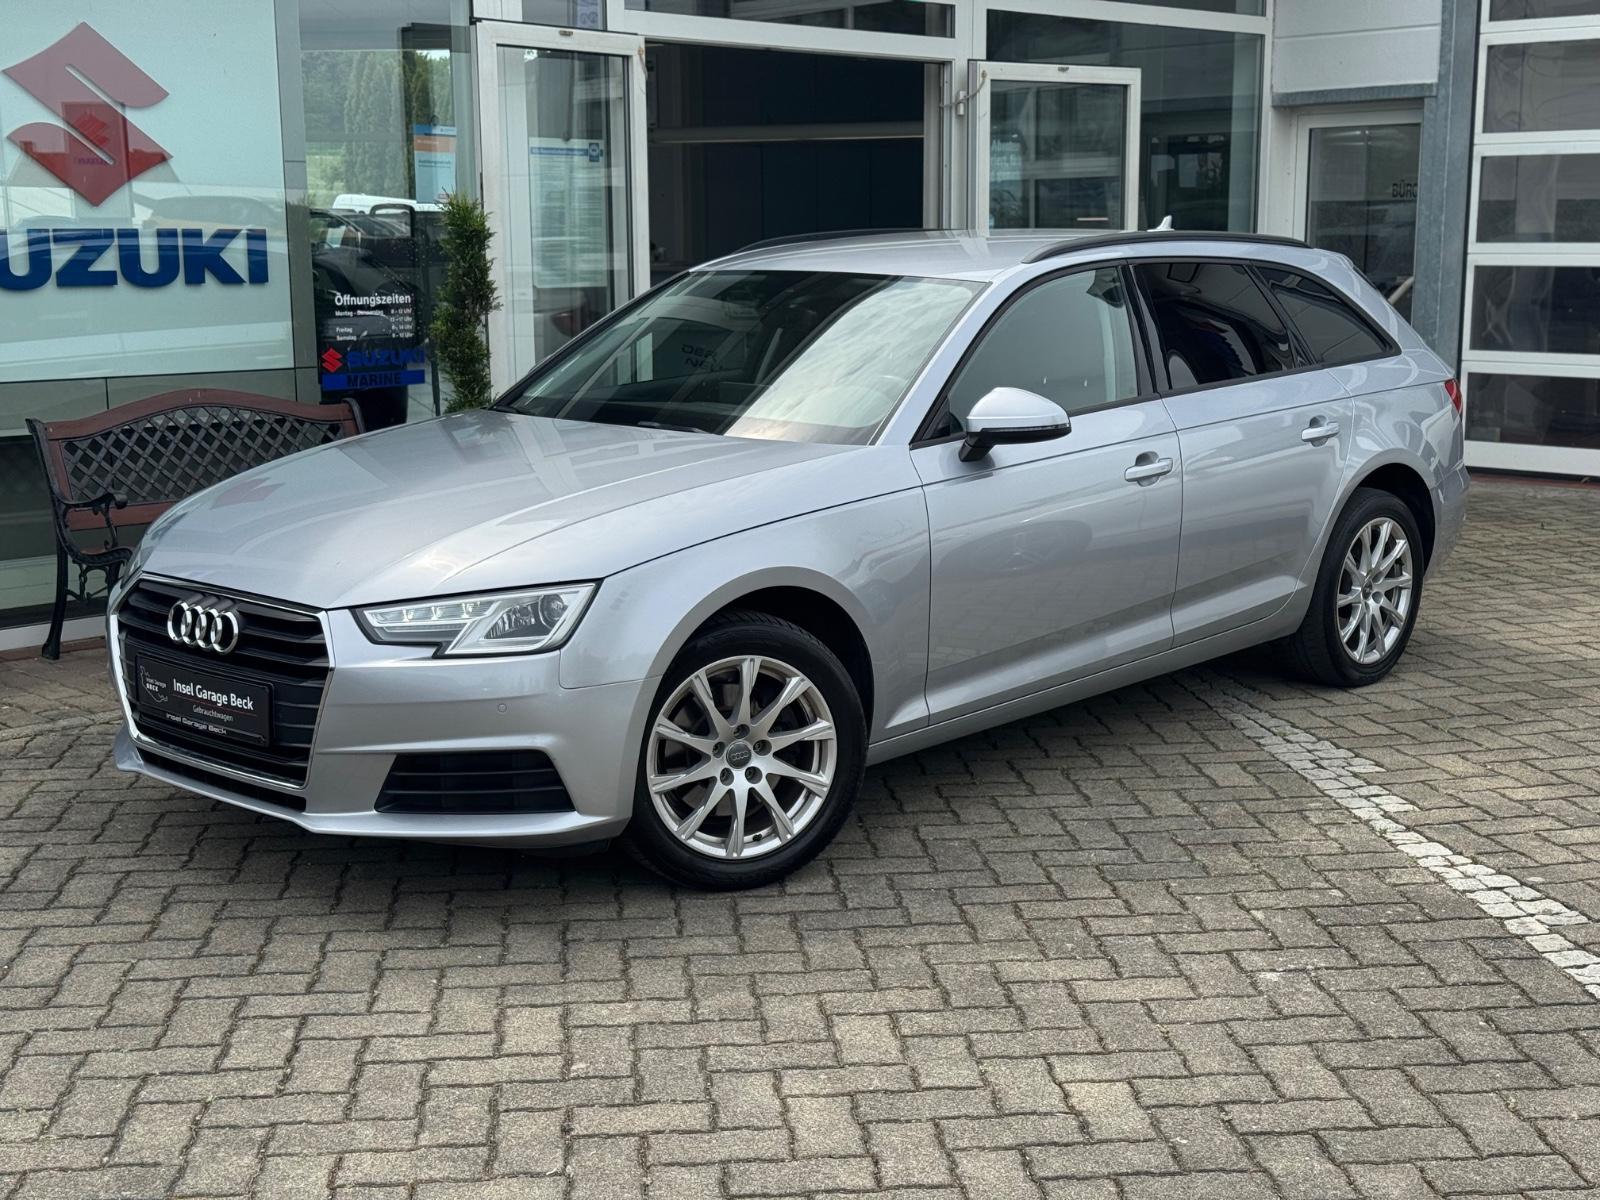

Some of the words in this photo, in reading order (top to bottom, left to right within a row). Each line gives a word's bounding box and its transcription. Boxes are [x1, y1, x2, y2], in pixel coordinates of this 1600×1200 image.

[0, 228, 269, 290] UZUKI
[335, 292, 411, 307] Öffnungszeiten
[348, 372, 400, 389] MARINE
[173, 678, 194, 697] Insel
[196, 684, 228, 706] Garage
[230, 693, 254, 711] Beck
[192, 704, 234, 722] Gebrauchtwagen
